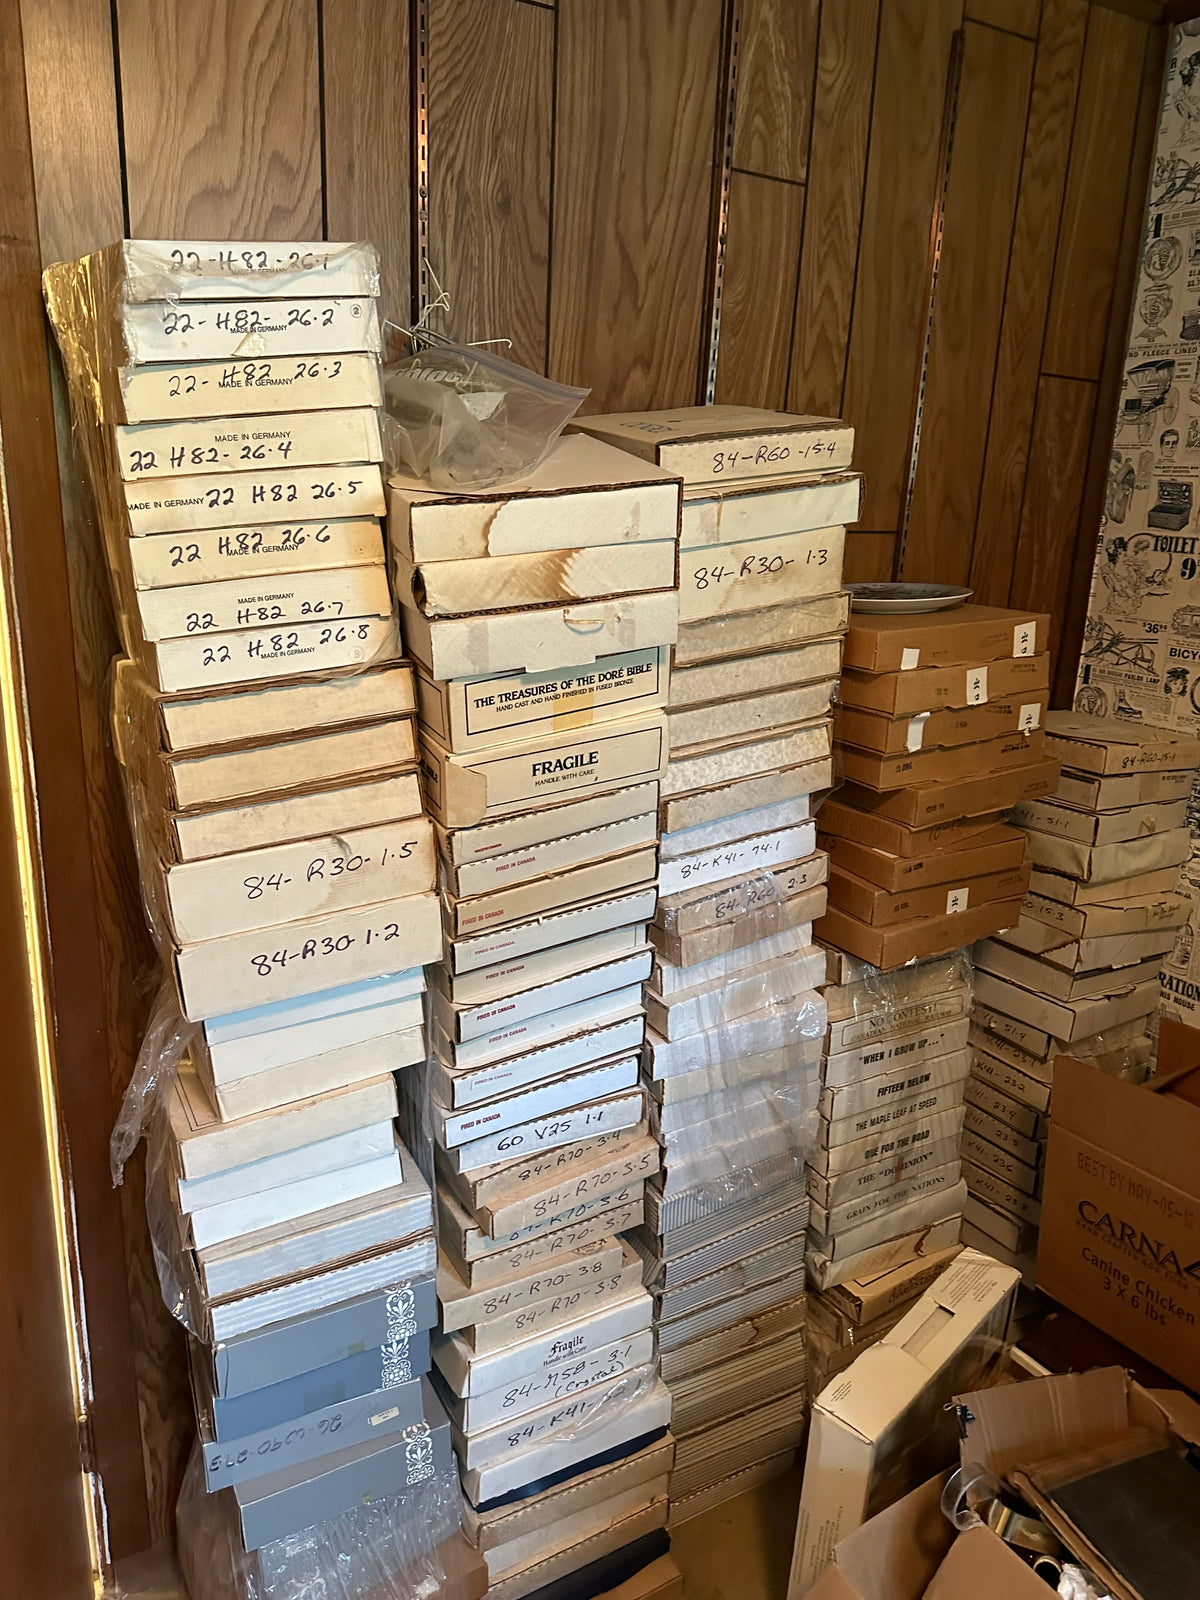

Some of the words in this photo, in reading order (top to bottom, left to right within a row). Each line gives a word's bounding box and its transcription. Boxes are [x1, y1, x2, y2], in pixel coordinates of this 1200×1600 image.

[257, 324, 287, 333] GERMANY
[1142, 348, 1171, 357] FLEECE
[1173, 347, 1198, 355] LINED
[218, 380, 242, 388] MADE
[254, 377, 293, 386] GERMANY
[214, 434, 239, 442] MADE
[251, 431, 292, 440] GERMANY
[129, 450, 158, 472] 22
[127, 501, 151, 511] MADE
[153, 500, 162, 508] IN
[163, 497, 204, 507] GERMANY
[205, 487, 236, 508] 22
[252, 483, 298, 502] H82
[169, 543, 202, 567] 22
[218, 532, 265, 555] H82
[226, 547, 250, 556] MADE
[261, 543, 300, 553] GERMANY
[264, 593, 295, 602] GERMANY
[186, 613, 219, 632] 22
[237, 606, 287, 625] H82
[202, 645, 232, 667] 22
[247, 632, 300, 657] H82
[260, 651, 279, 660] MADE
[286, 647, 316, 657] GERMANY
[474, 695, 496, 709] THE
[498, 683, 558, 704] TREASURES
[560, 679, 574, 691] OF
[576, 675, 597, 688] THE
[598, 666, 625, 683] DORÉ
[626, 662, 652, 676] BIBLE
[496, 703, 514, 712] HAND
[514, 700, 529, 709] CAST
[530, 697, 543, 705] AND
[596, 682, 613, 692] FUSED
[614, 677, 634, 688] BRONZE
[531, 751, 599, 777] FRAGILE
[534, 774, 561, 787] HANDLE
[561, 771, 578, 782] WITH
[578, 768, 595, 777] CARE
[495, 863, 510, 872] FIRED
[517, 856, 536, 867] CANADA
[462, 915, 477, 926] FIRED
[485, 909, 505, 920] CANADA
[474, 946, 489, 955] FIRED
[496, 940, 515, 949] CANADA
[486, 971, 500, 980] FIRED
[506, 964, 525, 974] CANADA
[476, 1012, 491, 1021] FIRED
[497, 1004, 516, 1014] CANADA
[1173, 996, 1195, 1012] HOUSE
[869, 1017, 886, 1029] NO
[488, 1034, 502, 1044] FIRED
[509, 1027, 527, 1037] CANADA
[894, 1044, 916, 1057] GROW
[494, 1071, 513, 1080] CANADA
[877, 1080, 905, 1098] FIFTEEN
[907, 1072, 931, 1088] BELOW
[461, 1121, 475, 1130] FIRED
[482, 1113, 501, 1123] CANADA
[856, 1120, 868, 1132] THE
[869, 1111, 891, 1128] MAPLE
[892, 1107, 908, 1120] LEAF
[908, 1103, 917, 1113] AT
[918, 1096, 937, 1111] SPEED
[497, 1136, 524, 1151] 60
[864, 1148, 878, 1160] ONE
[880, 1142, 895, 1153] FOR
[897, 1137, 910, 1149] THE
[911, 1129, 930, 1145] ROAD
[1077, 1151, 1106, 1182] BEST
[1108, 1169, 1124, 1188] BY
[856, 1173, 876, 1186] THE
[846, 1204, 871, 1221] GRAIN
[873, 1198, 891, 1209] FOR
[893, 1189, 908, 1202] THE
[911, 1175, 946, 1193] NATIONS
[1082, 1247, 1130, 1286] Canine
[1135, 1280, 1196, 1327] Chicken
[1103, 1278, 1112, 1291] 3
[1130, 1295, 1140, 1310] 6
[1145, 1301, 1167, 1328] lbs
[549, 1334, 586, 1358] Fragile
[543, 1354, 562, 1368] Handle
[562, 1351, 574, 1361] with
[574, 1345, 588, 1358] Care
